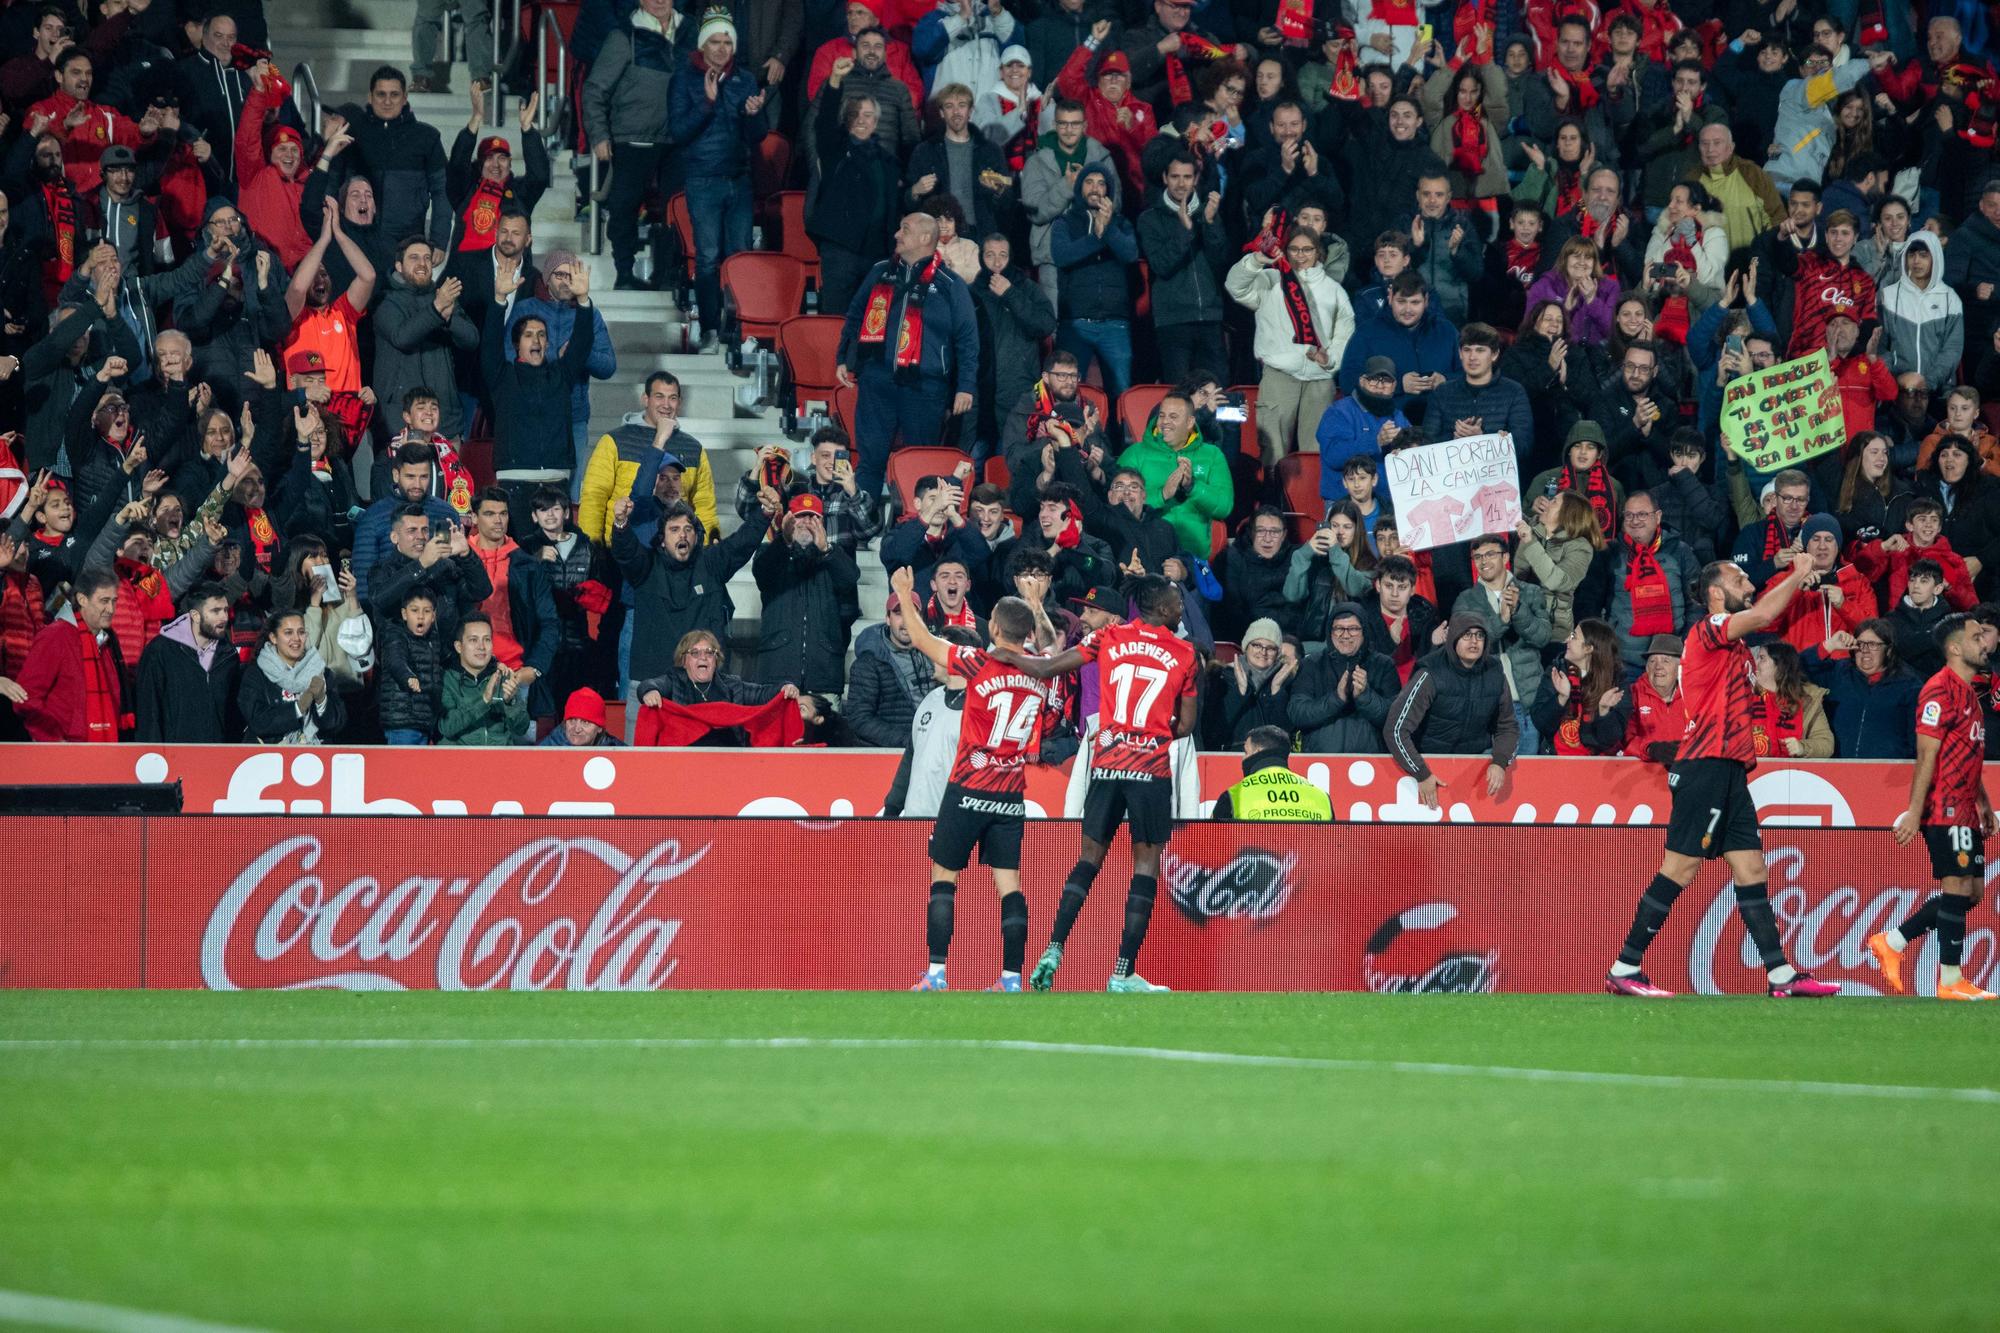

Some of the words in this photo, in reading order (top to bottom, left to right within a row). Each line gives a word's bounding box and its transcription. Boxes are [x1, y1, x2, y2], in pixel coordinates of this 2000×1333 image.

[1729, 406, 1751, 421] TU
[1743, 419, 1766, 437] POR
[1771, 405, 1808, 427] FAVOR
[1742, 432, 1769, 453] SOY
[1771, 422, 1800, 440] TU
[1410, 479, 1434, 497] LA
[1443, 460, 1517, 488] CAMISETA
[1486, 503, 1503, 522] 14
[1108, 641, 1179, 671] KADEWERE
[974, 675, 1005, 698] DANI
[1109, 662, 1169, 728] 17
[986, 689, 1043, 751] 14
[1114, 733, 1160, 750] ALUA
[1267, 790, 1300, 803] 040
[1263, 808, 1322, 821] PROSEGUR
[1709, 807, 1722, 833] 7
[1948, 825, 1973, 851] 18
[200, 835, 712, 991] Coca-Cola
